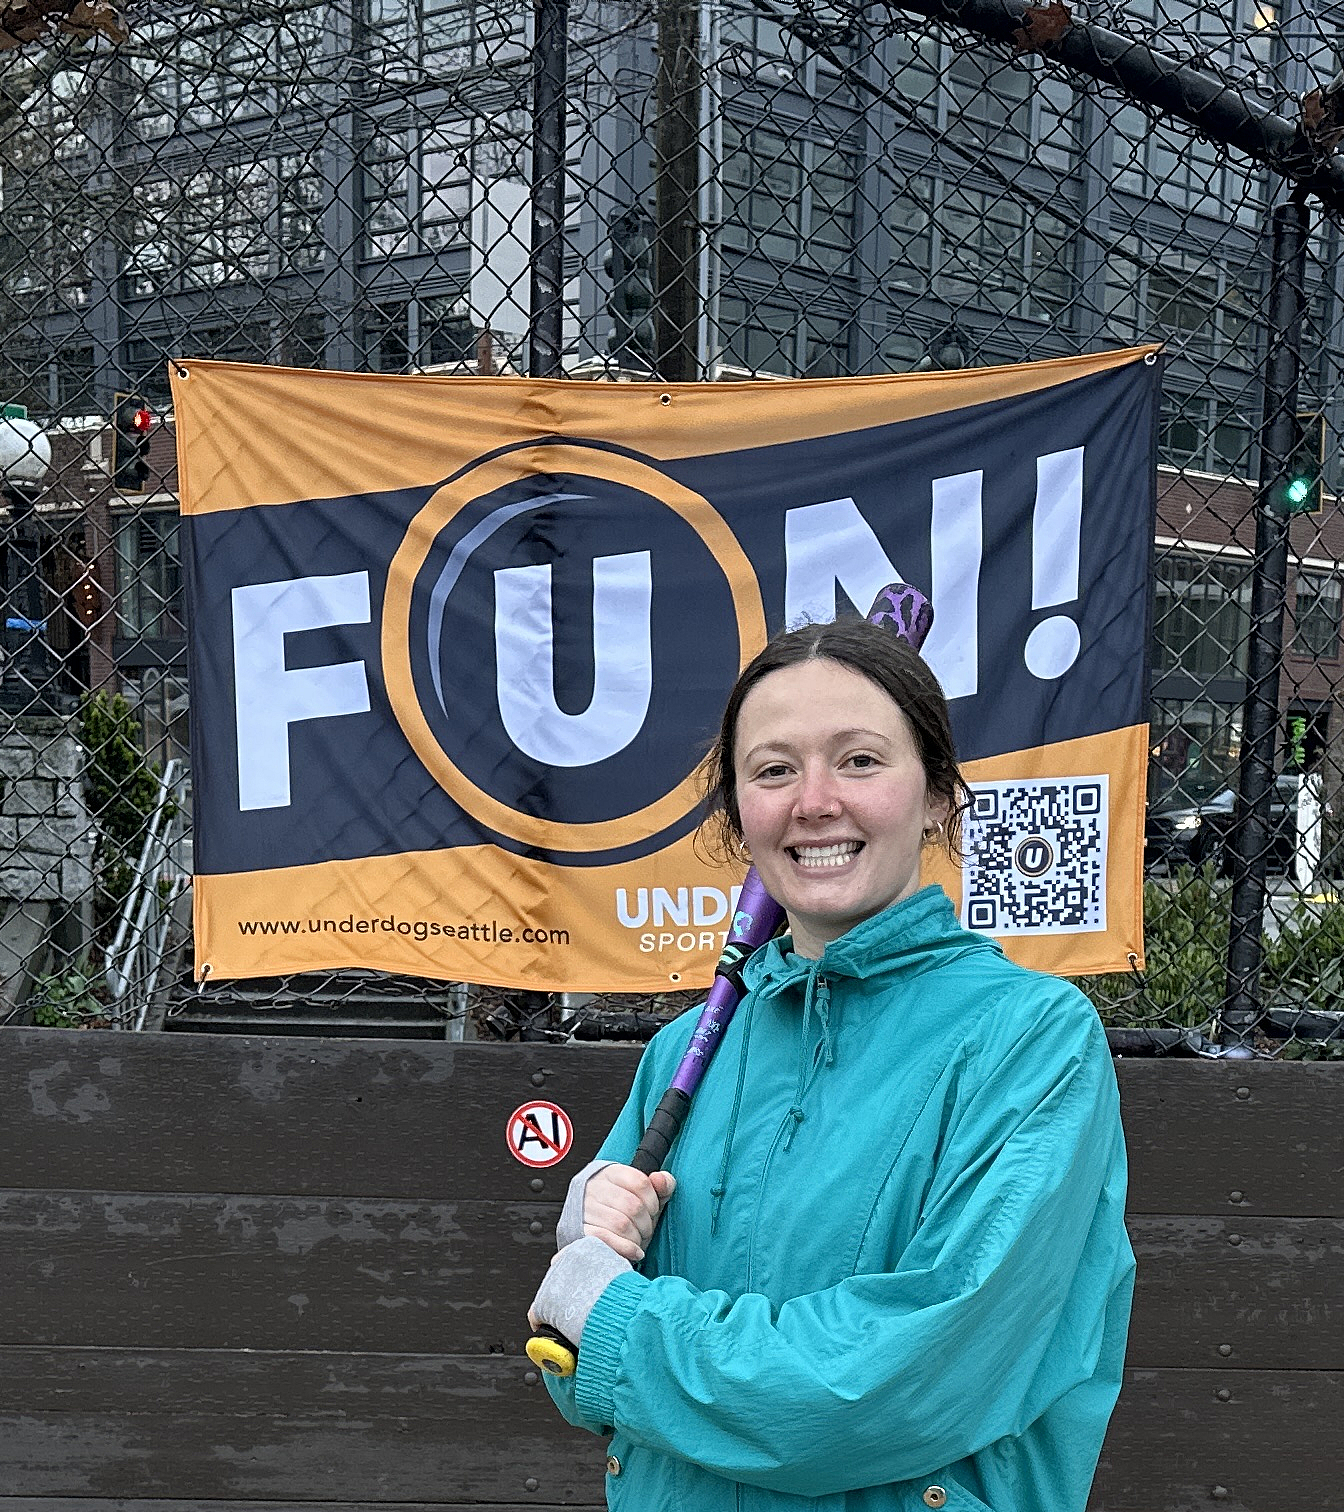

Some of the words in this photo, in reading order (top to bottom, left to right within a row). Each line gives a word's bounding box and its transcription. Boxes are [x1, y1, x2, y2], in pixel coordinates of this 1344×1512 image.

[231, 445, 1086, 812] FUN!
[1025, 847, 1044, 869] U
[238, 904, 571, 945] www.underdogseattle.com
[517, 1111, 561, 1151] AI
